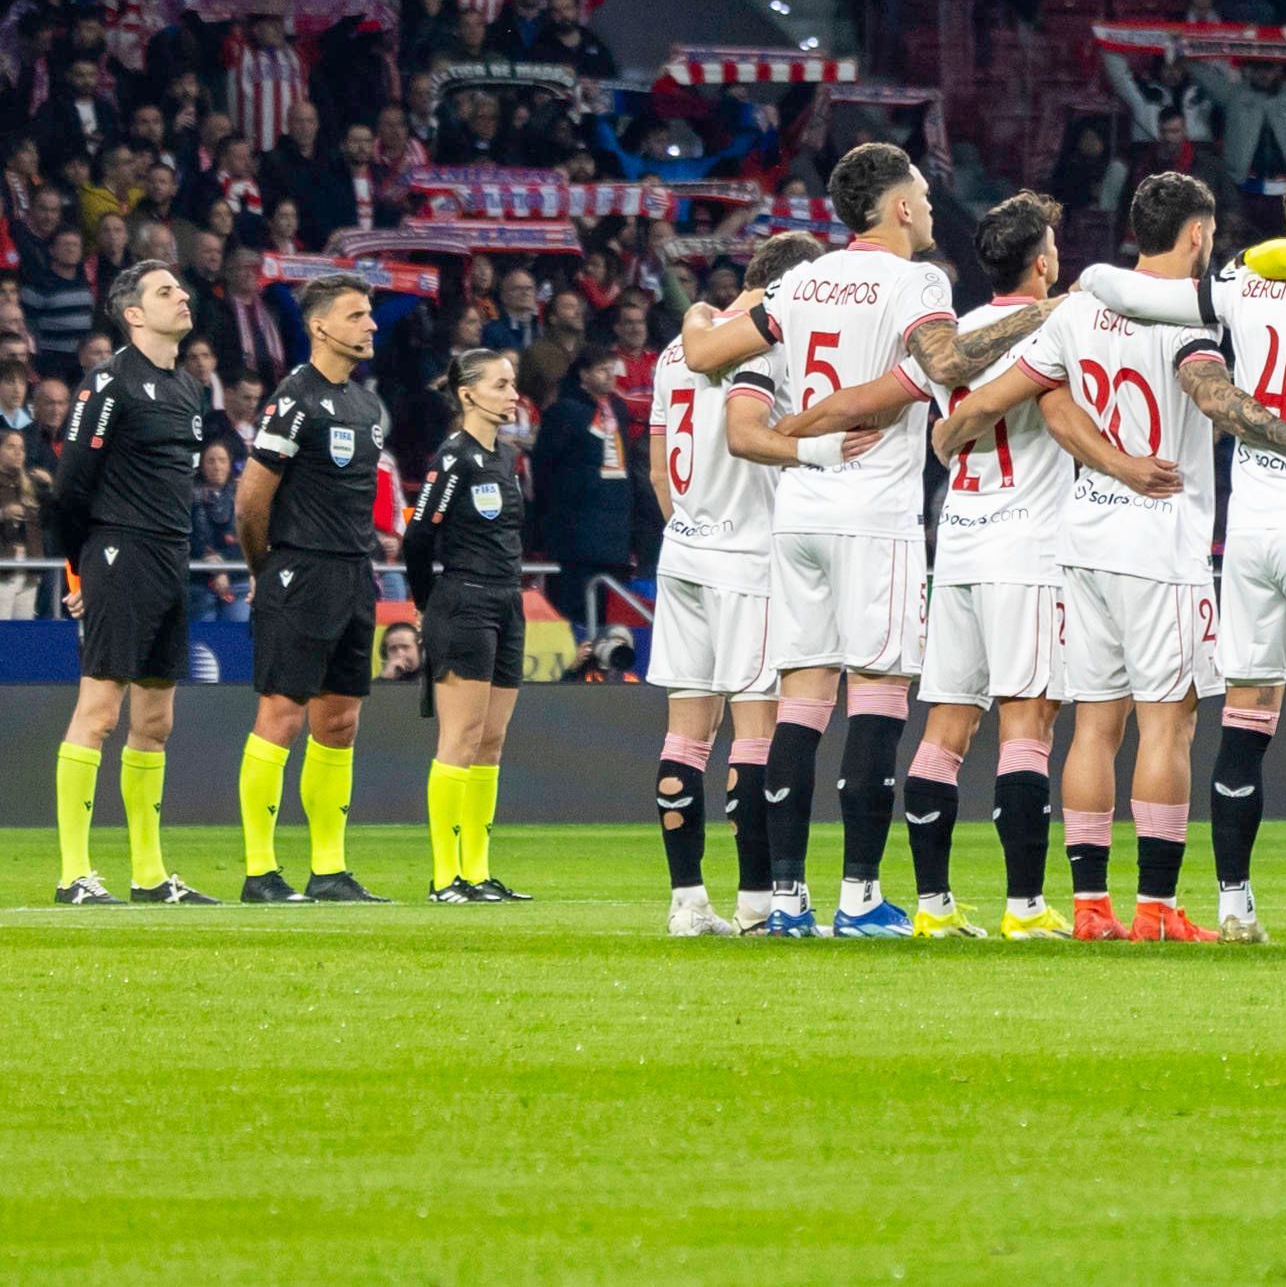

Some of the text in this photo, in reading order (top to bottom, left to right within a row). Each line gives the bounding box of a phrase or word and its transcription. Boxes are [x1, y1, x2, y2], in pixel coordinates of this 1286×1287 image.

[793, 278, 881, 306] LOCAMPOS
[1092, 307, 1135, 336] ISAC
[801, 330, 842, 412] 5
[1078, 358, 1162, 458] 20
[333, 430, 352, 441] FIFA
[668, 388, 696, 496] 3
[474, 486, 496, 495] FIFA
